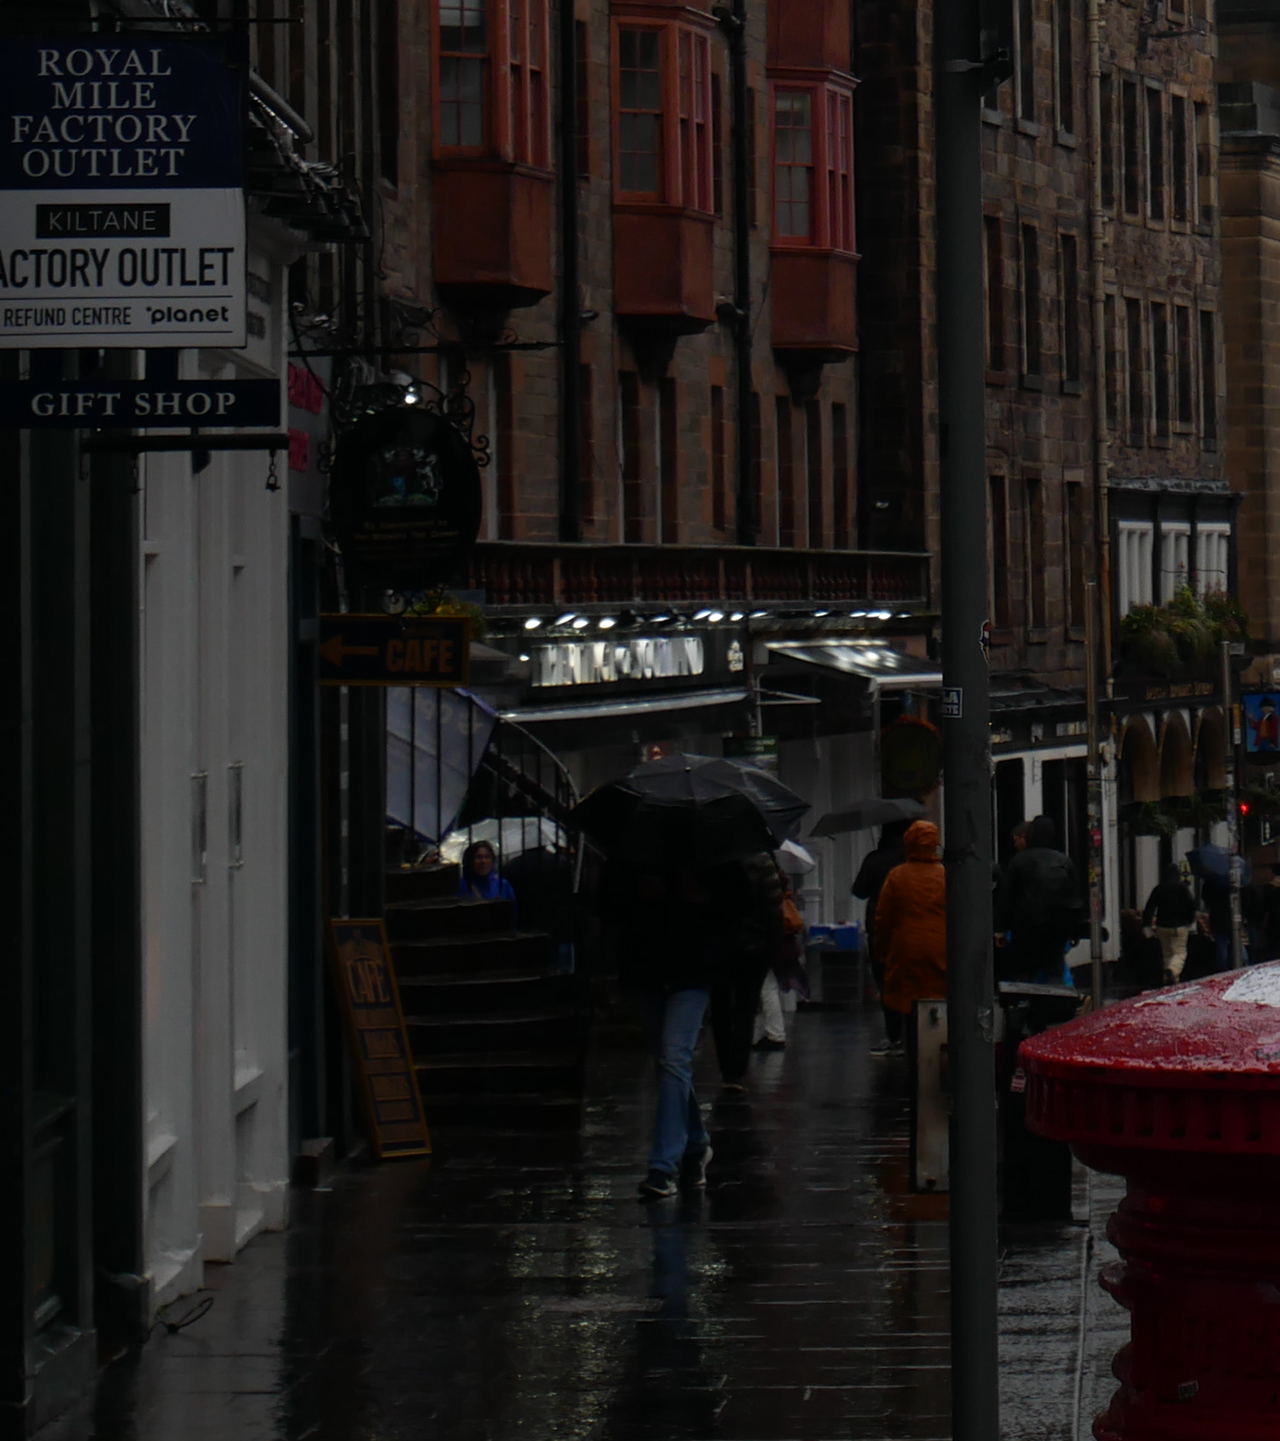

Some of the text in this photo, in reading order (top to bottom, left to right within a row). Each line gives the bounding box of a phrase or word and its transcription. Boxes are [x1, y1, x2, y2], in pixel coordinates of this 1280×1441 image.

[37, 48, 173, 77] ROYAL
[51, 81, 157, 110] MILE
[11, 114, 198, 144] FACTORY
[22, 148, 186, 178] OUTLET
[48, 210, 157, 231] KILTANE
[119, 247, 234, 287] OUTLET
[4, 306, 229, 327] REFUND CENTRE planet
[31, 392, 237, 418] GIFT SHOP
[386, 639, 454, 674] CAFE
